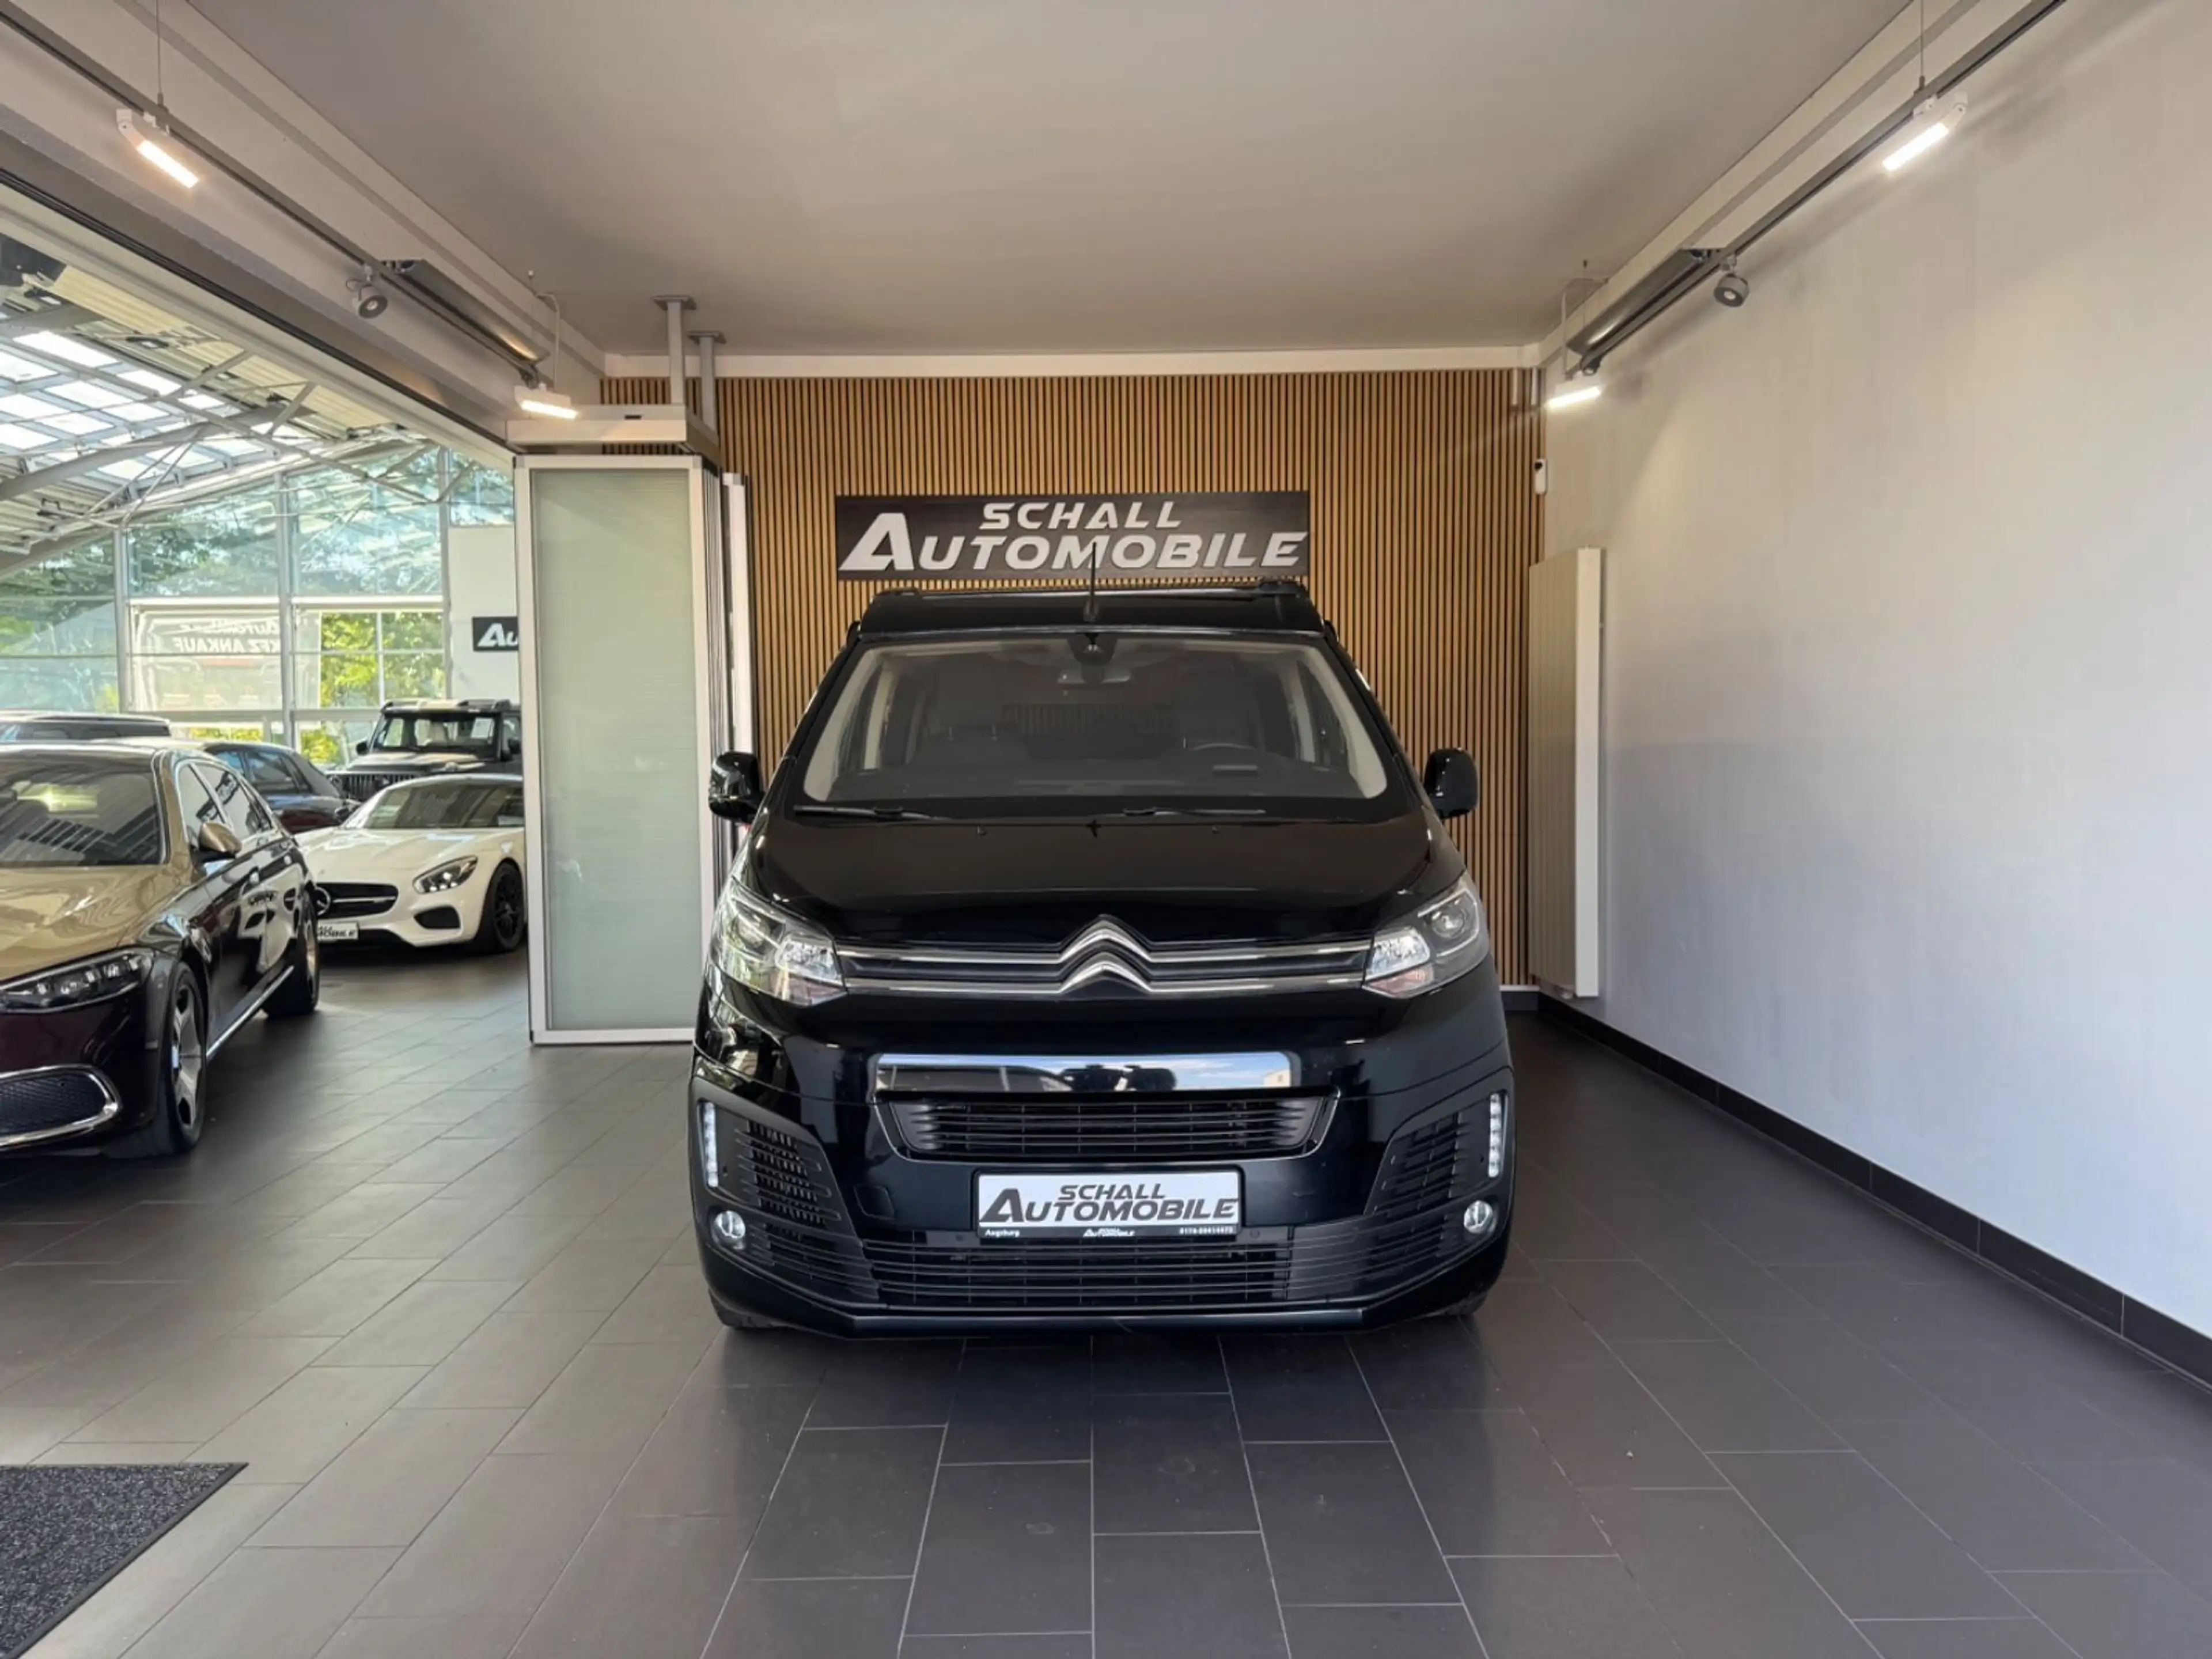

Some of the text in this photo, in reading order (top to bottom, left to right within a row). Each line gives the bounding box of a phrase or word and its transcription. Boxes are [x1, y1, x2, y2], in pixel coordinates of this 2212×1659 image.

[979, 501, 1181, 530] SCHALL
[838, 512, 1309, 571] AUTOMOBILE
[979, 1187, 1239, 1222] AUTOMOBILE
[1058, 1183, 1166, 1200] SCHALL
